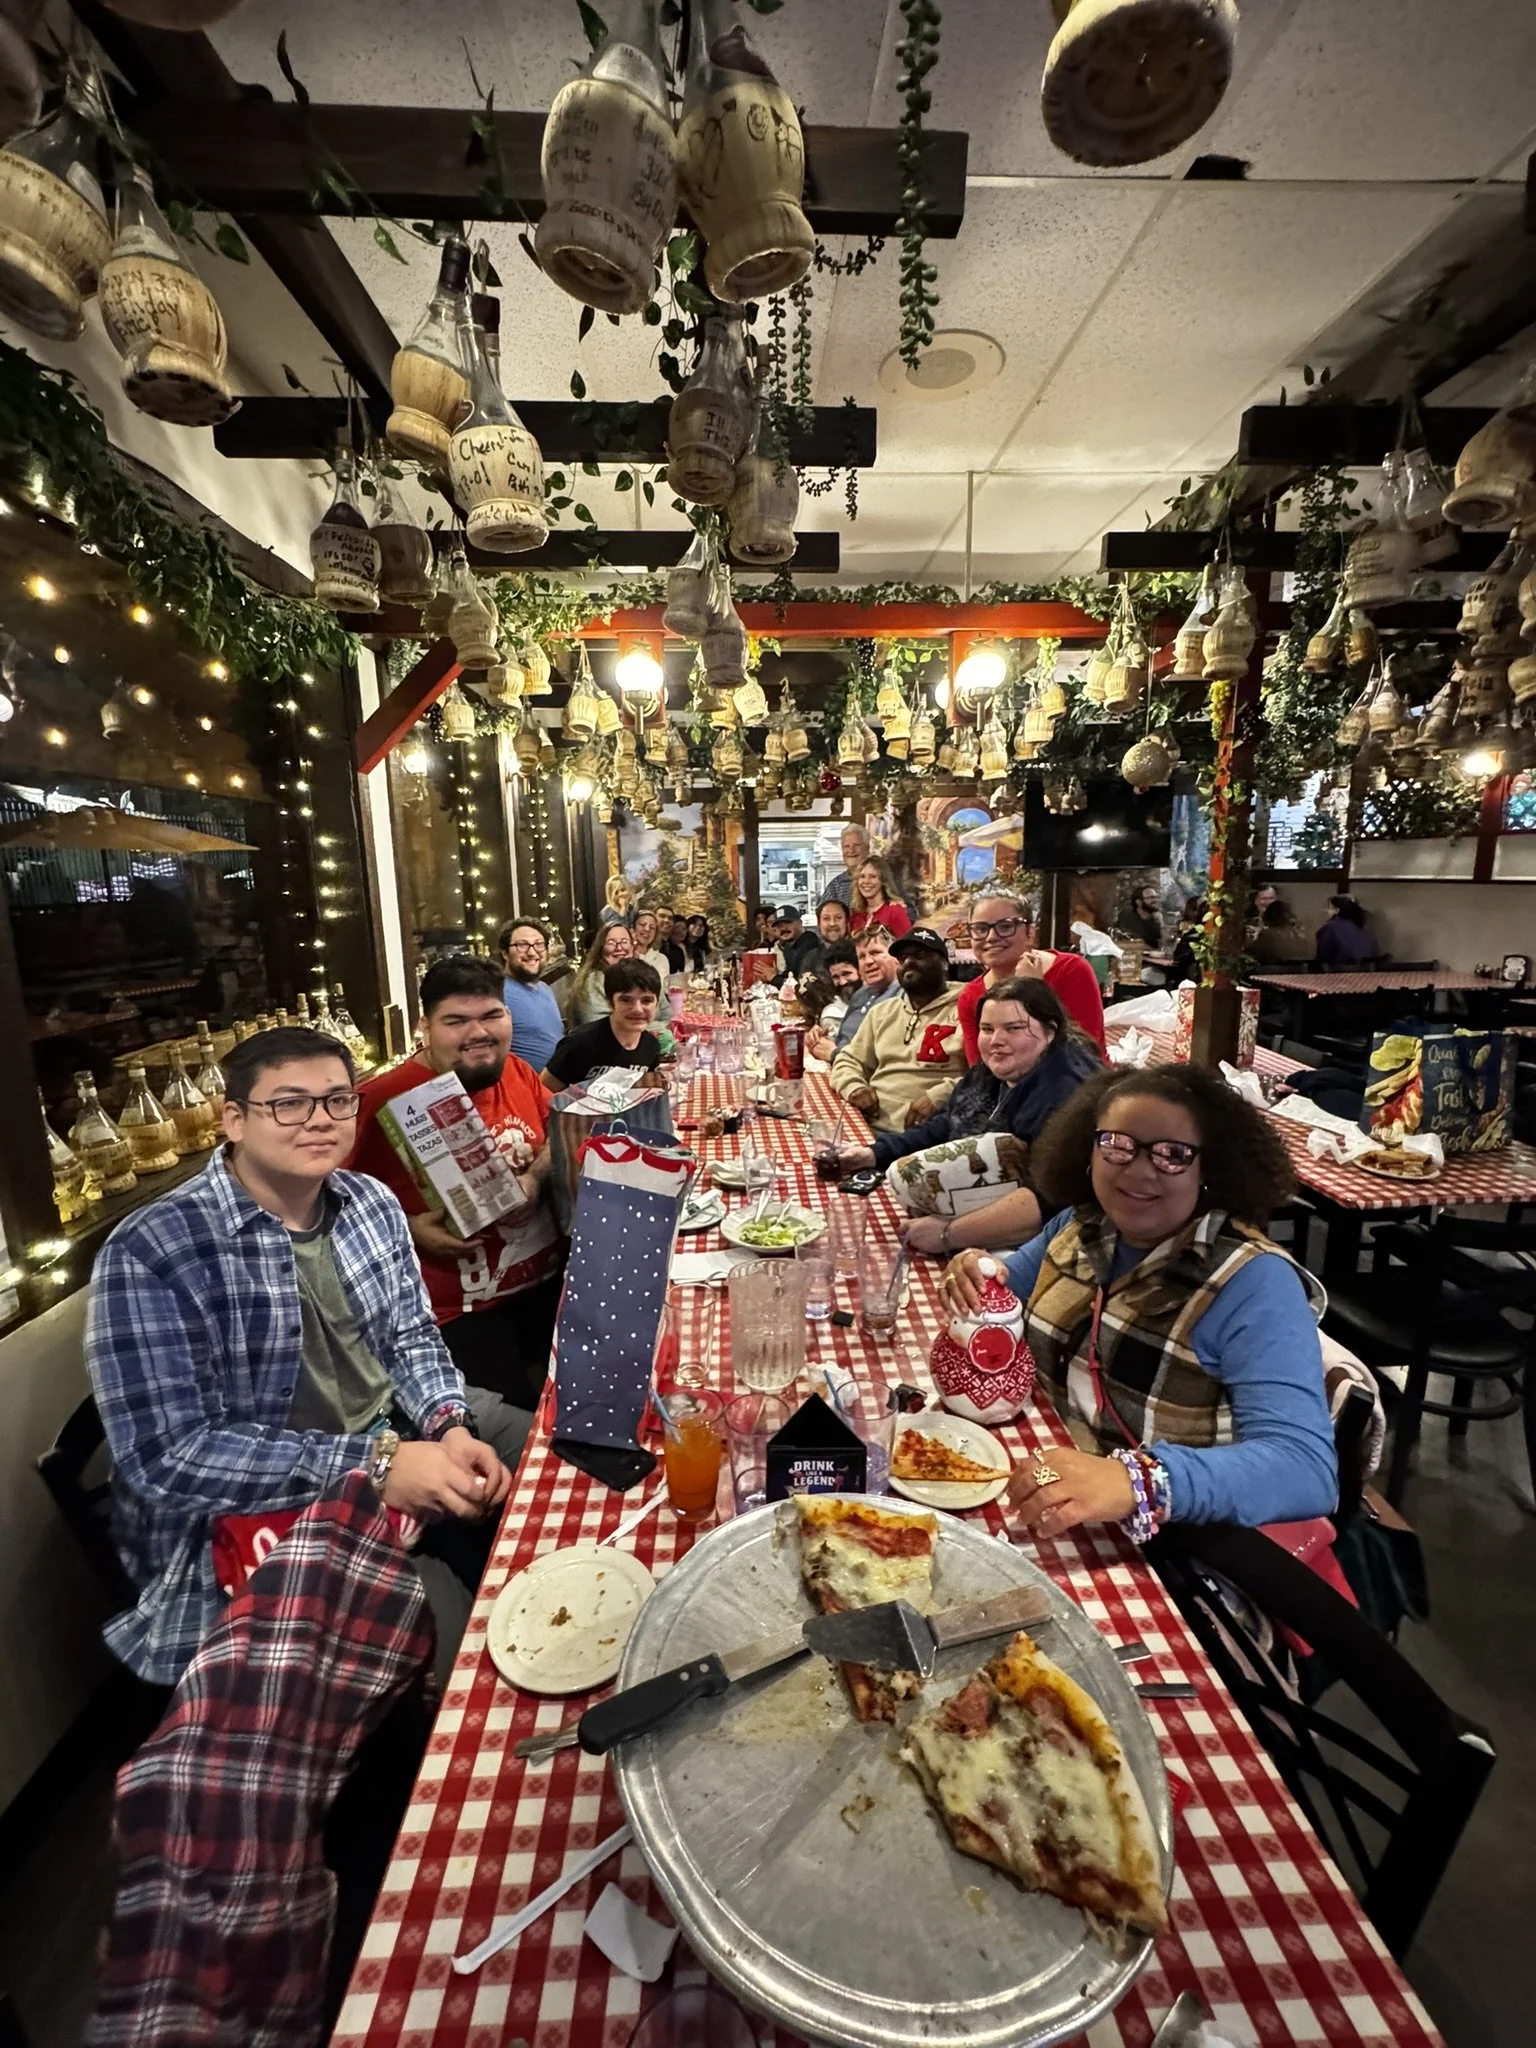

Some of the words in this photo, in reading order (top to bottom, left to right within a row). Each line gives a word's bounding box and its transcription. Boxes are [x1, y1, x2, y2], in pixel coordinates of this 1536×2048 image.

[916, 1024, 957, 1063] K
[406, 1105, 417, 1116] 4
[404, 1113, 429, 1130] MUGS
[408, 1124, 438, 1143] TASSES
[417, 1136, 443, 1154] TAZAS
[793, 1460, 835, 1472] DRINK
[793, 1475, 836, 1487] LEGEND
